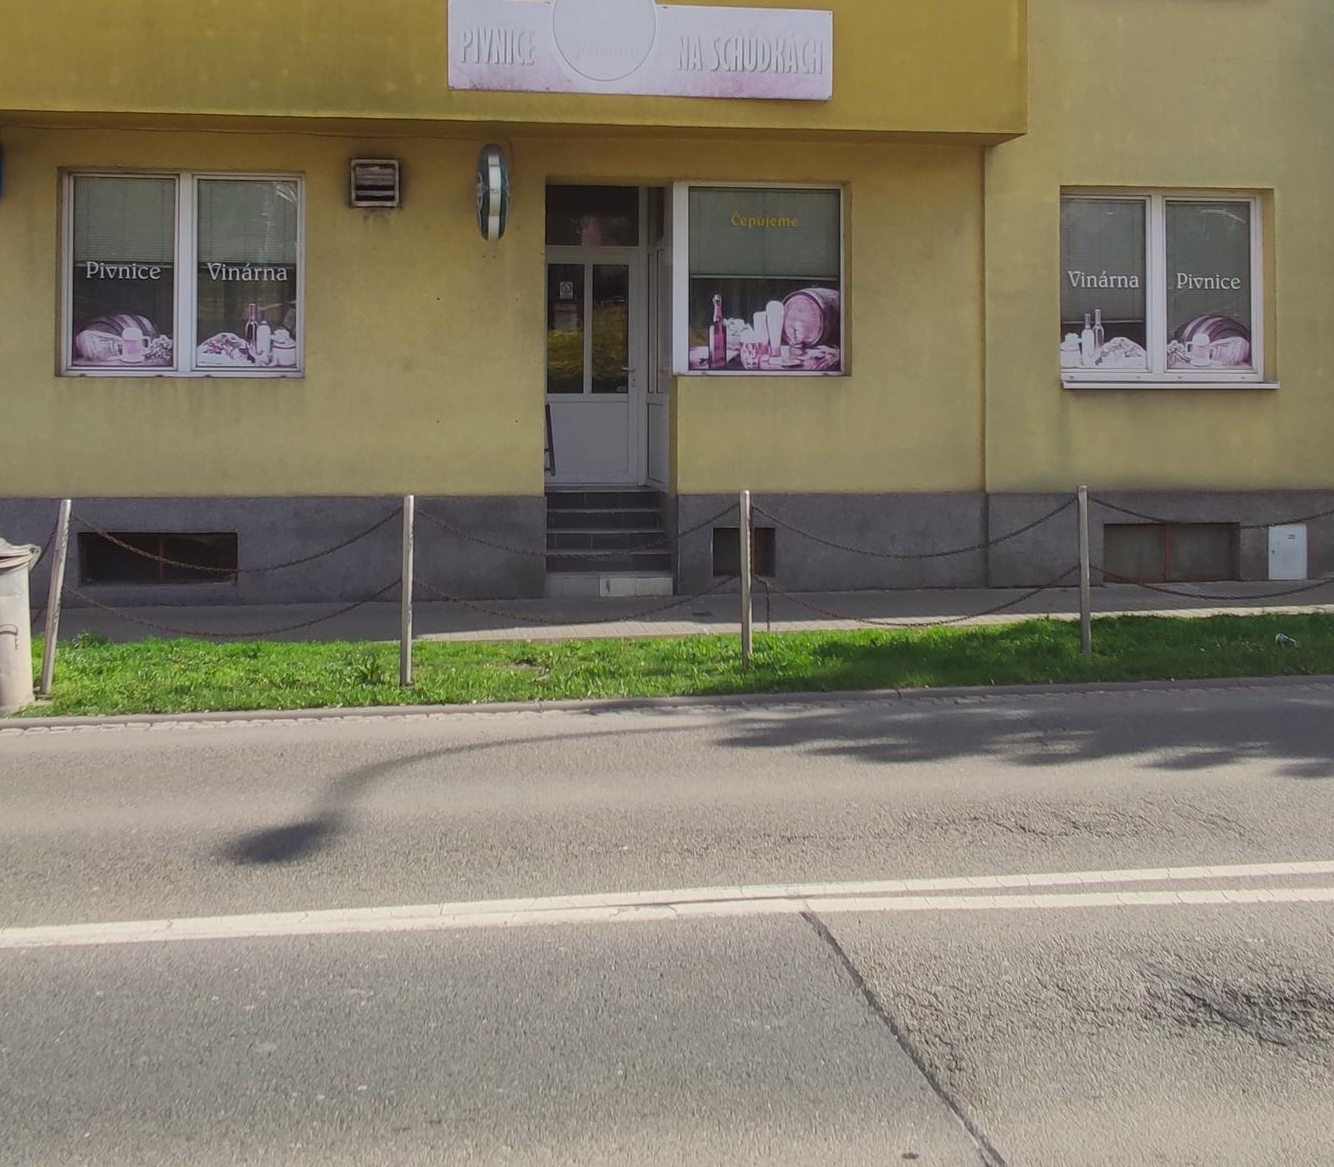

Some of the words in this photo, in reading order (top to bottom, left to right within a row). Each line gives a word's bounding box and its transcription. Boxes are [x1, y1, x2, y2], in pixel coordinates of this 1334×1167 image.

[460, 26, 536, 65] PIVNICE
[677, 34, 704, 71] NA
[730, 211, 799, 229] Čepujeme
[85, 261, 162, 280] Pivnice
[207, 262, 288, 281] Vinárna
[1067, 270, 1140, 288] Vinárna
[1175, 272, 1241, 290] Pivnice
